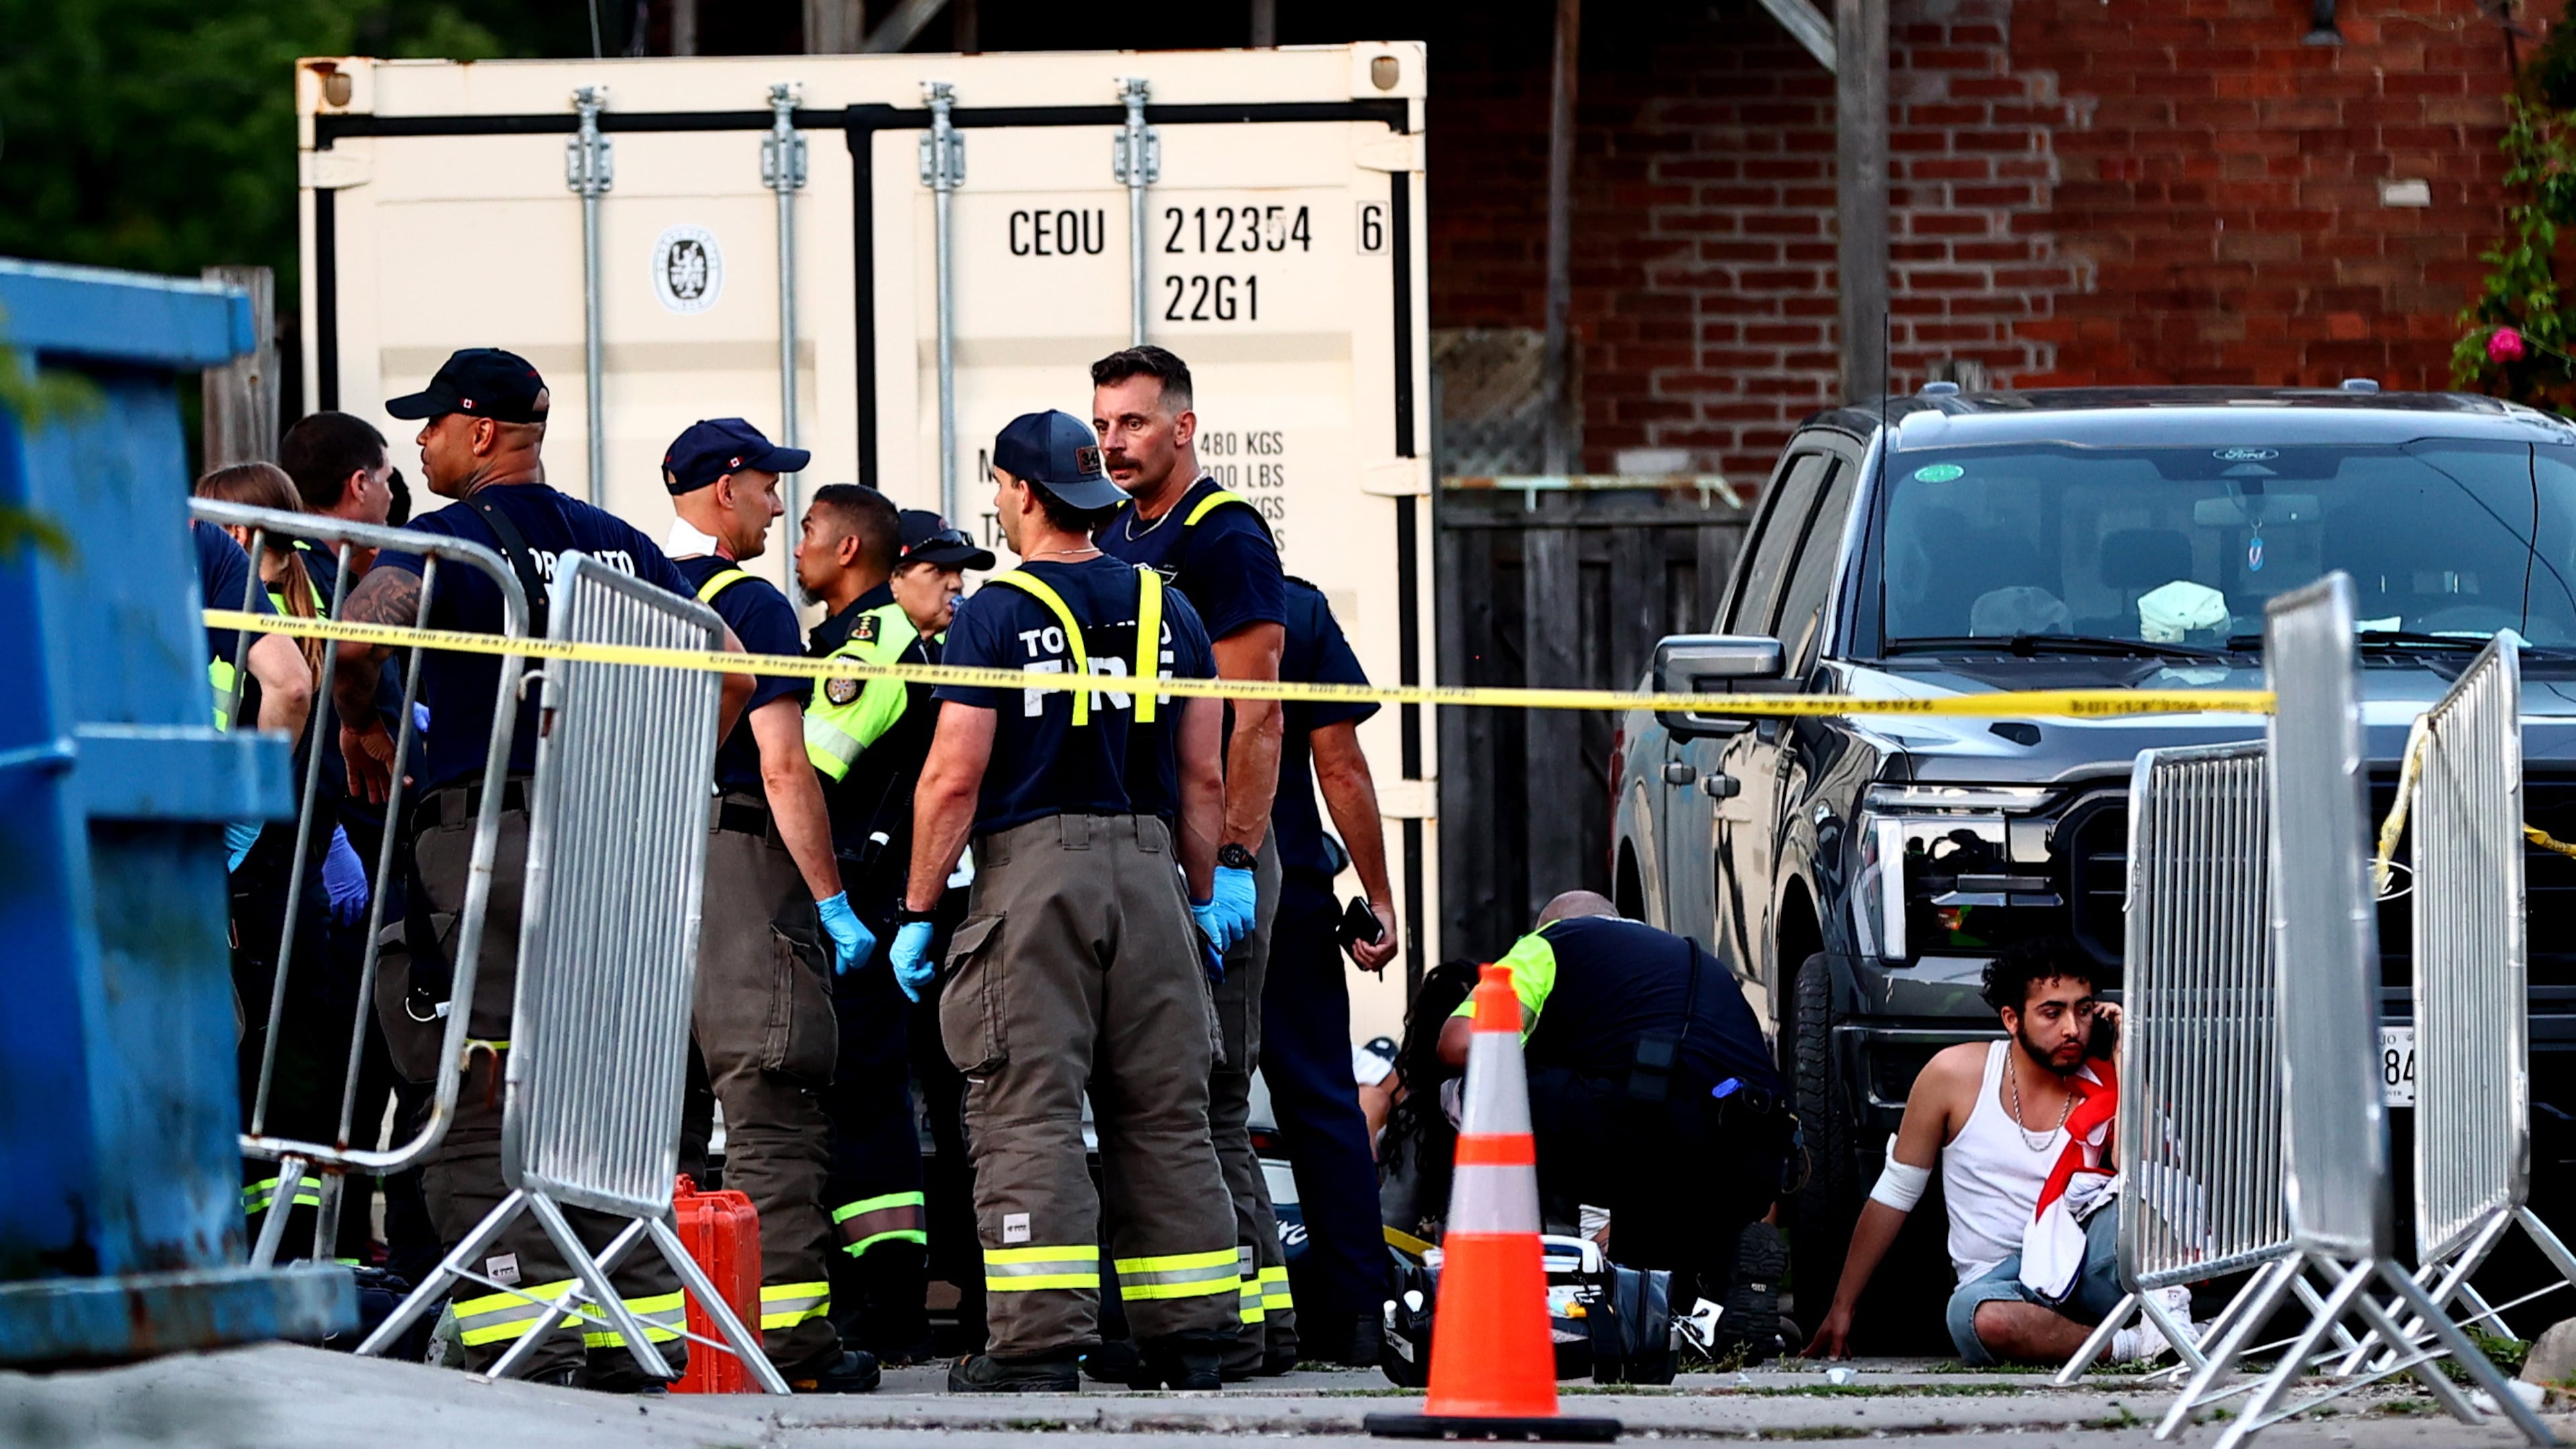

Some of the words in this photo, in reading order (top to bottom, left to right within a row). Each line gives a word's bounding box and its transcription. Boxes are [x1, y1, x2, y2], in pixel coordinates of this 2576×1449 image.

[1010, 210, 1104, 256] CEOU
[1165, 206, 1311, 253] 212354
[1363, 207, 1382, 251] 6
[1165, 275, 1257, 321] 22G1
[1247, 431, 1283, 455] KGS
[1248, 464, 1284, 488] LBS
[260, 619, 307, 629] Crime
[314, 623, 384, 636] Stoppers
